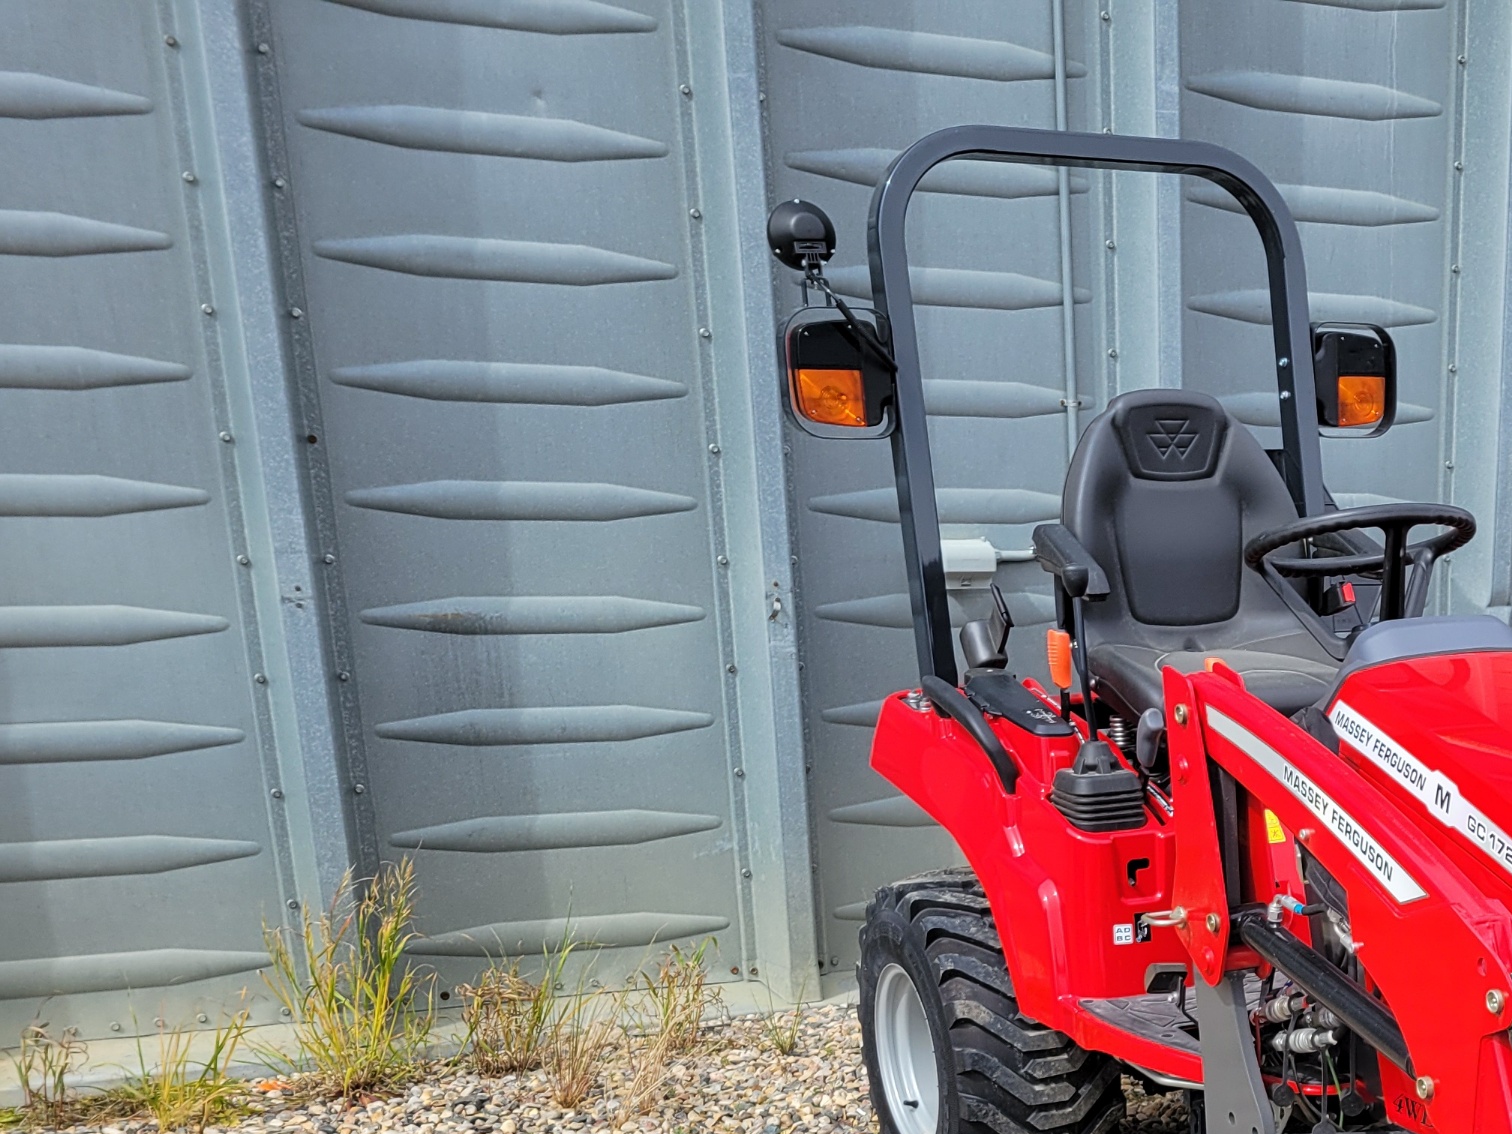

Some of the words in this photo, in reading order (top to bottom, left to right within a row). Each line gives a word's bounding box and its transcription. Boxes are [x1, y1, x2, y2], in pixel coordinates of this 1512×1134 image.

[1283, 765, 1329, 816] MASSEY
[1331, 809, 1393, 882] FERGUSON
[1334, 711, 1373, 747] MASSEY
[1372, 738, 1427, 791] FERGUSON
[1434, 783, 1452, 814] M
[1467, 815, 1487, 840] GC
